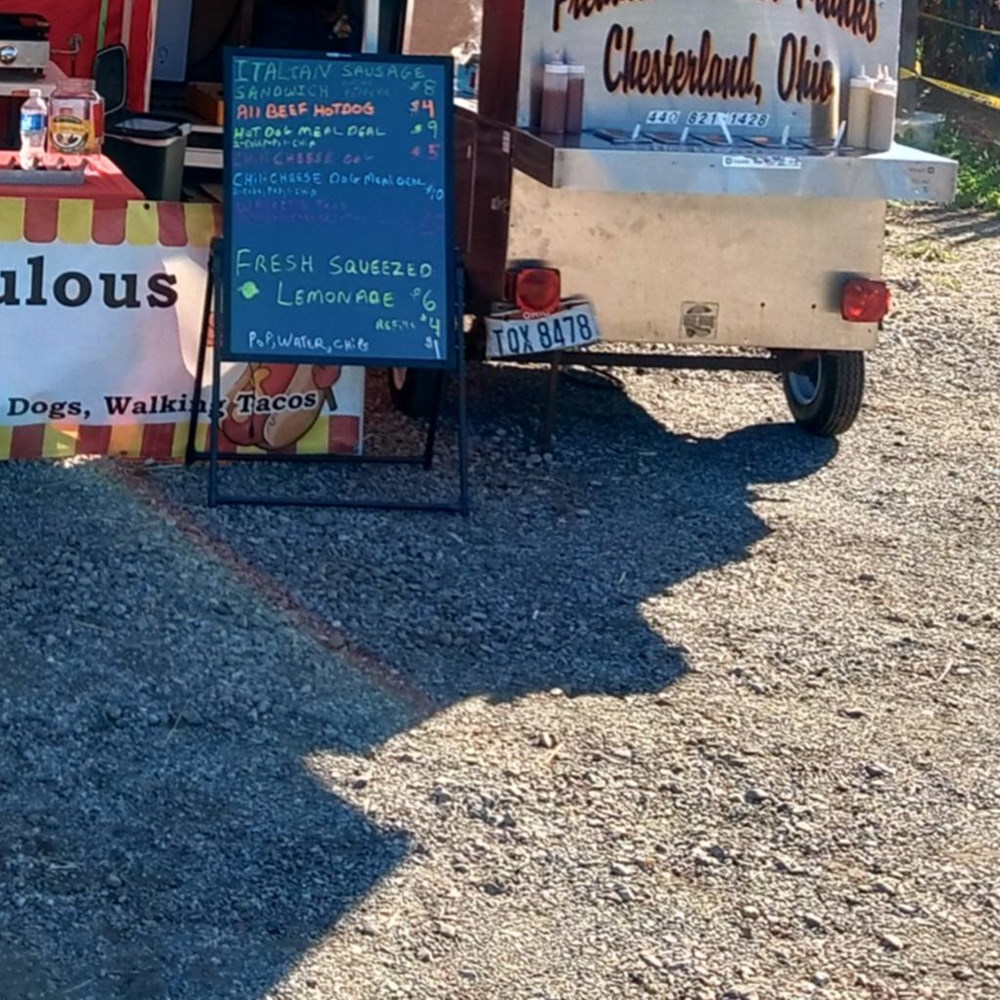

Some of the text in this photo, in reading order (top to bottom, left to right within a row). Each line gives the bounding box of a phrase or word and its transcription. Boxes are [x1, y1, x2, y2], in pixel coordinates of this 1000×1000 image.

[233, 59, 426, 83] ITALIAN SAUSAGE
[602, 22, 836, 105] Chesterland, Ohio
[234, 85, 330, 100] SANDWICH
[265, 102, 309, 120] BEEF
[409, 99, 436, 119] $4
[648, 111, 680, 124] 440
[298, 125, 345, 138] MEAL
[347, 124, 387, 138] DEAL
[236, 248, 433, 279] FRESH SQUEEZED
[277, 280, 437, 312] LEMONADE $6
[537, 313, 593, 349] 8478
[6, 396, 91, 420] Dogs,
[237, 390, 318, 413] Tacos
